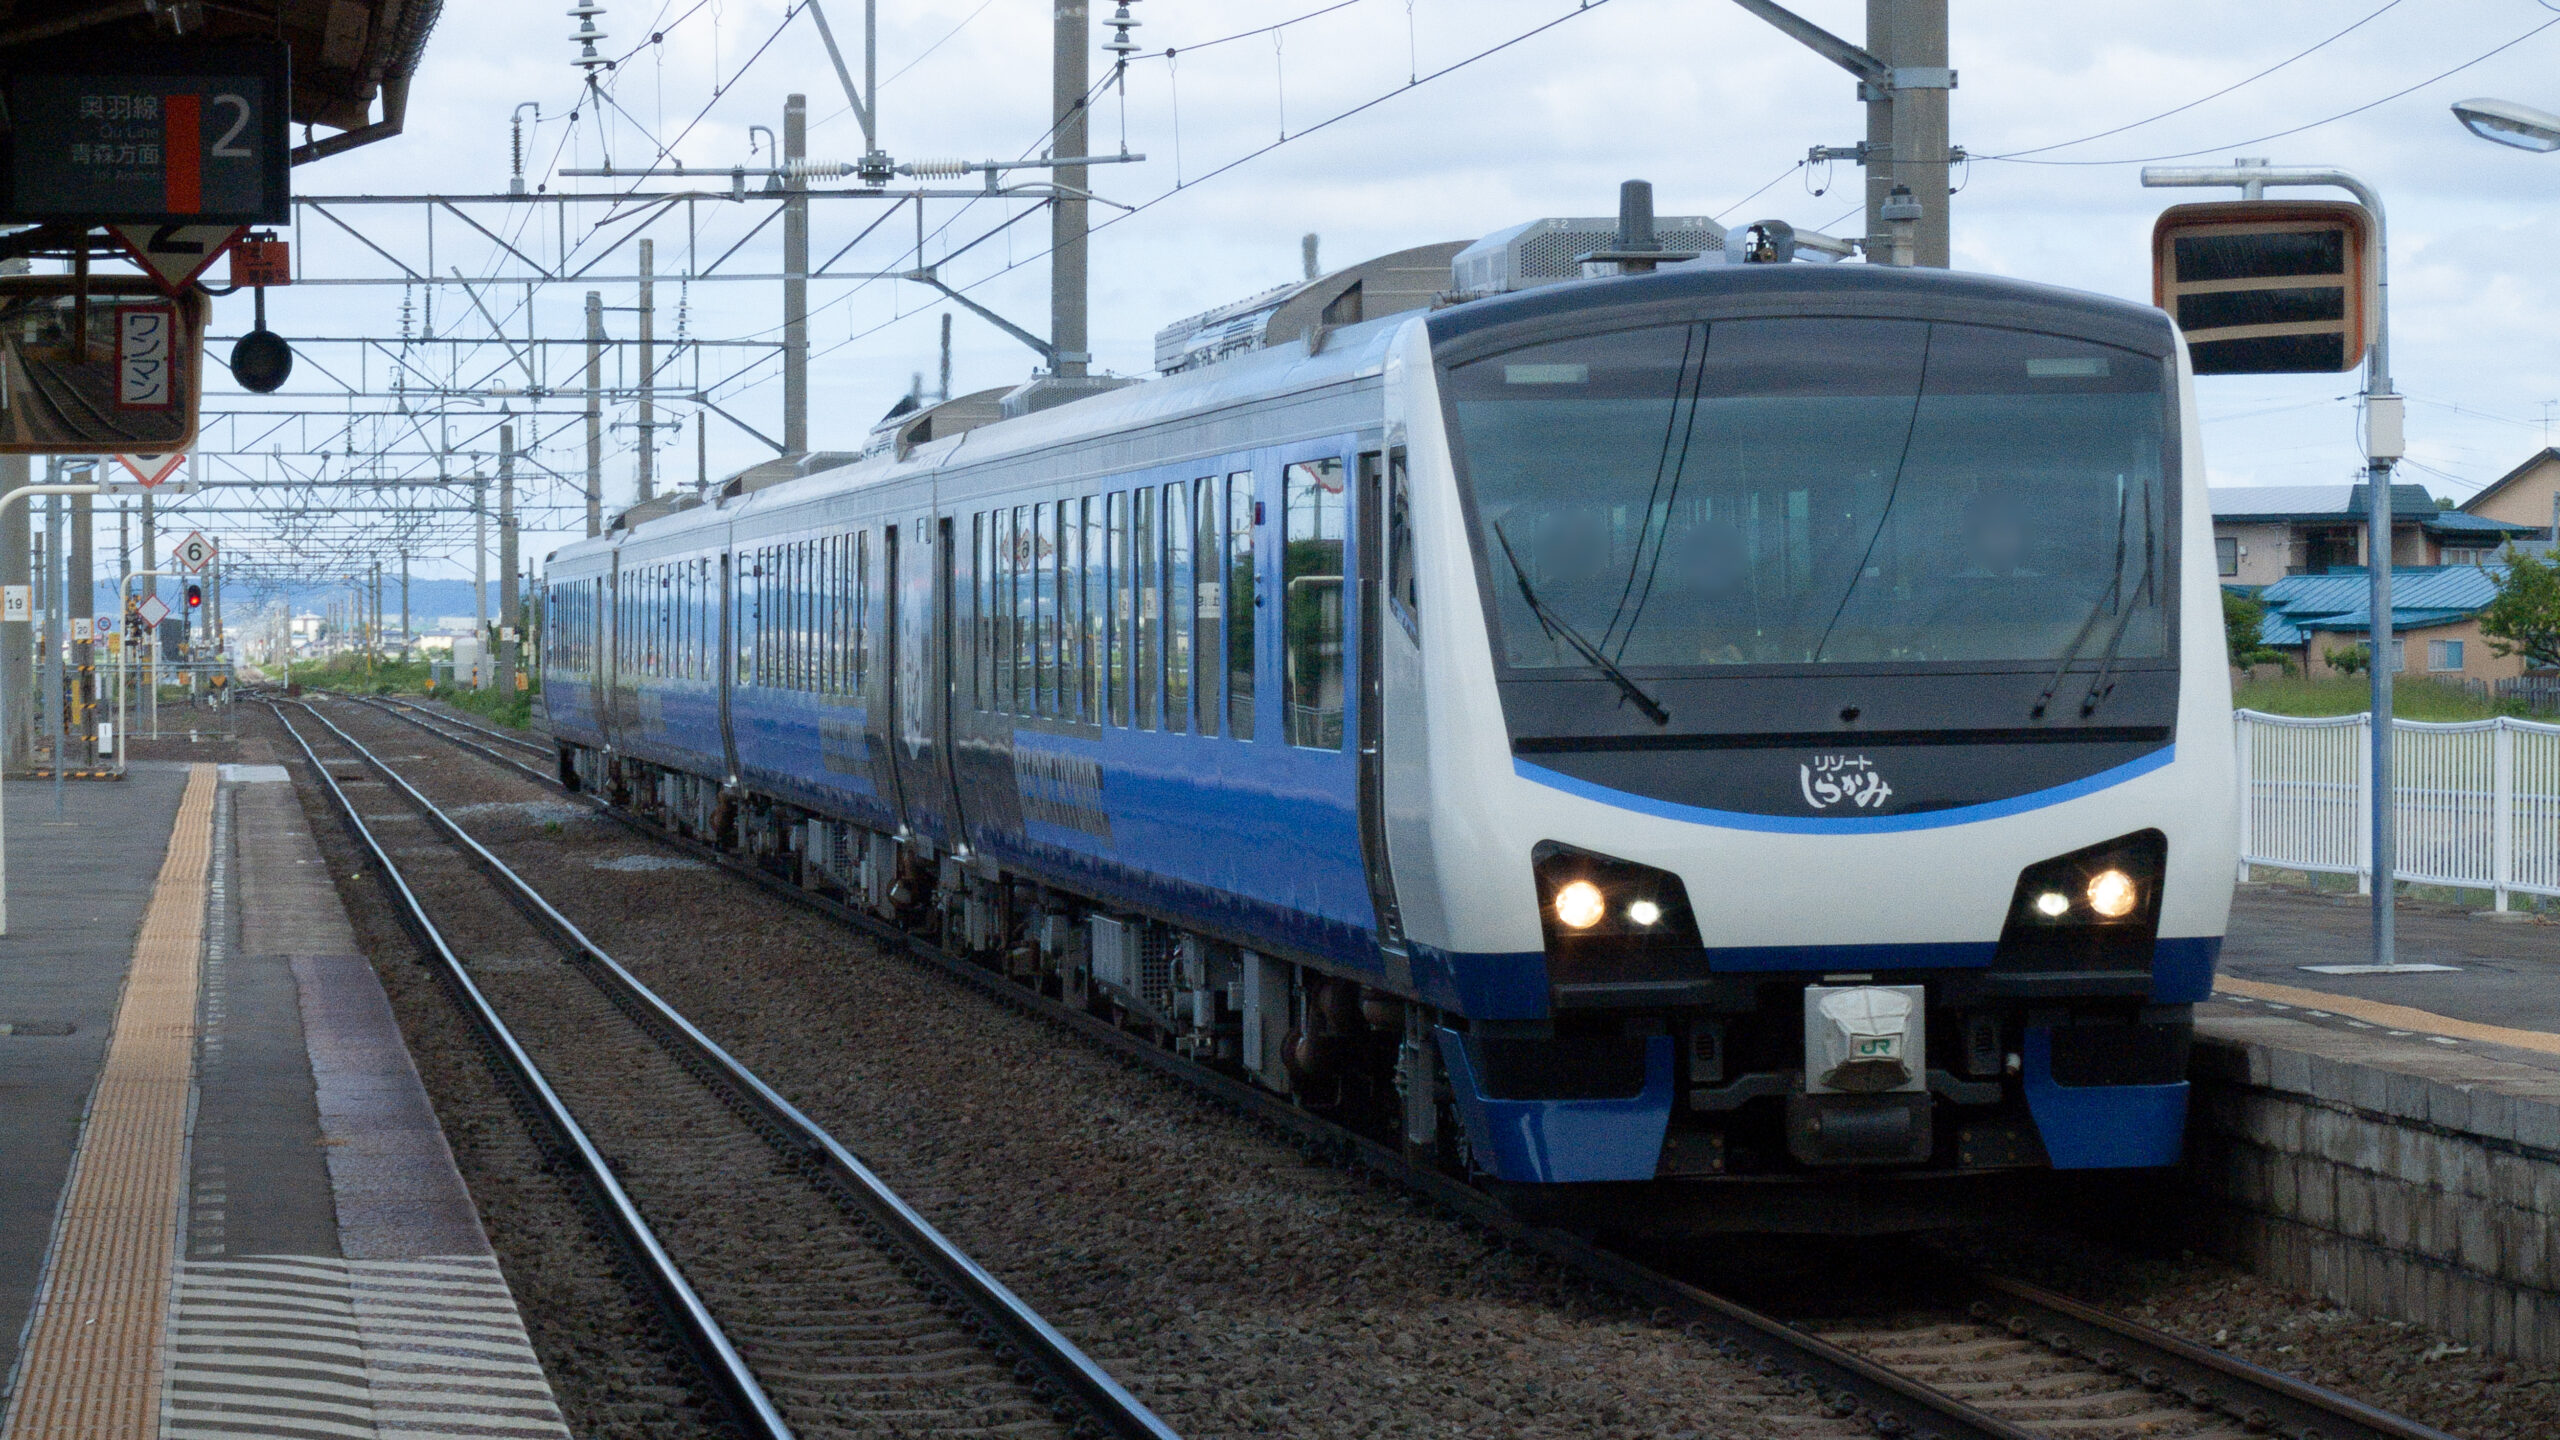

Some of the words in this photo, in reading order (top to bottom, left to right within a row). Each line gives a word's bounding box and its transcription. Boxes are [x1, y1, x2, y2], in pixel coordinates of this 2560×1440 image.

[80, 95, 158, 119] 奥羽線
[211, 94, 251, 157] 2
[70, 142, 160, 165] 青森方面
[130, 315, 160, 401] ワンマン
[188, 542, 202, 562] 6
[8, 598, 23, 610] 19
[1814, 754, 1873, 772] リゾート
[1800, 763, 1893, 809] しらかみ
[1861, 1039, 1890, 1055] JR
